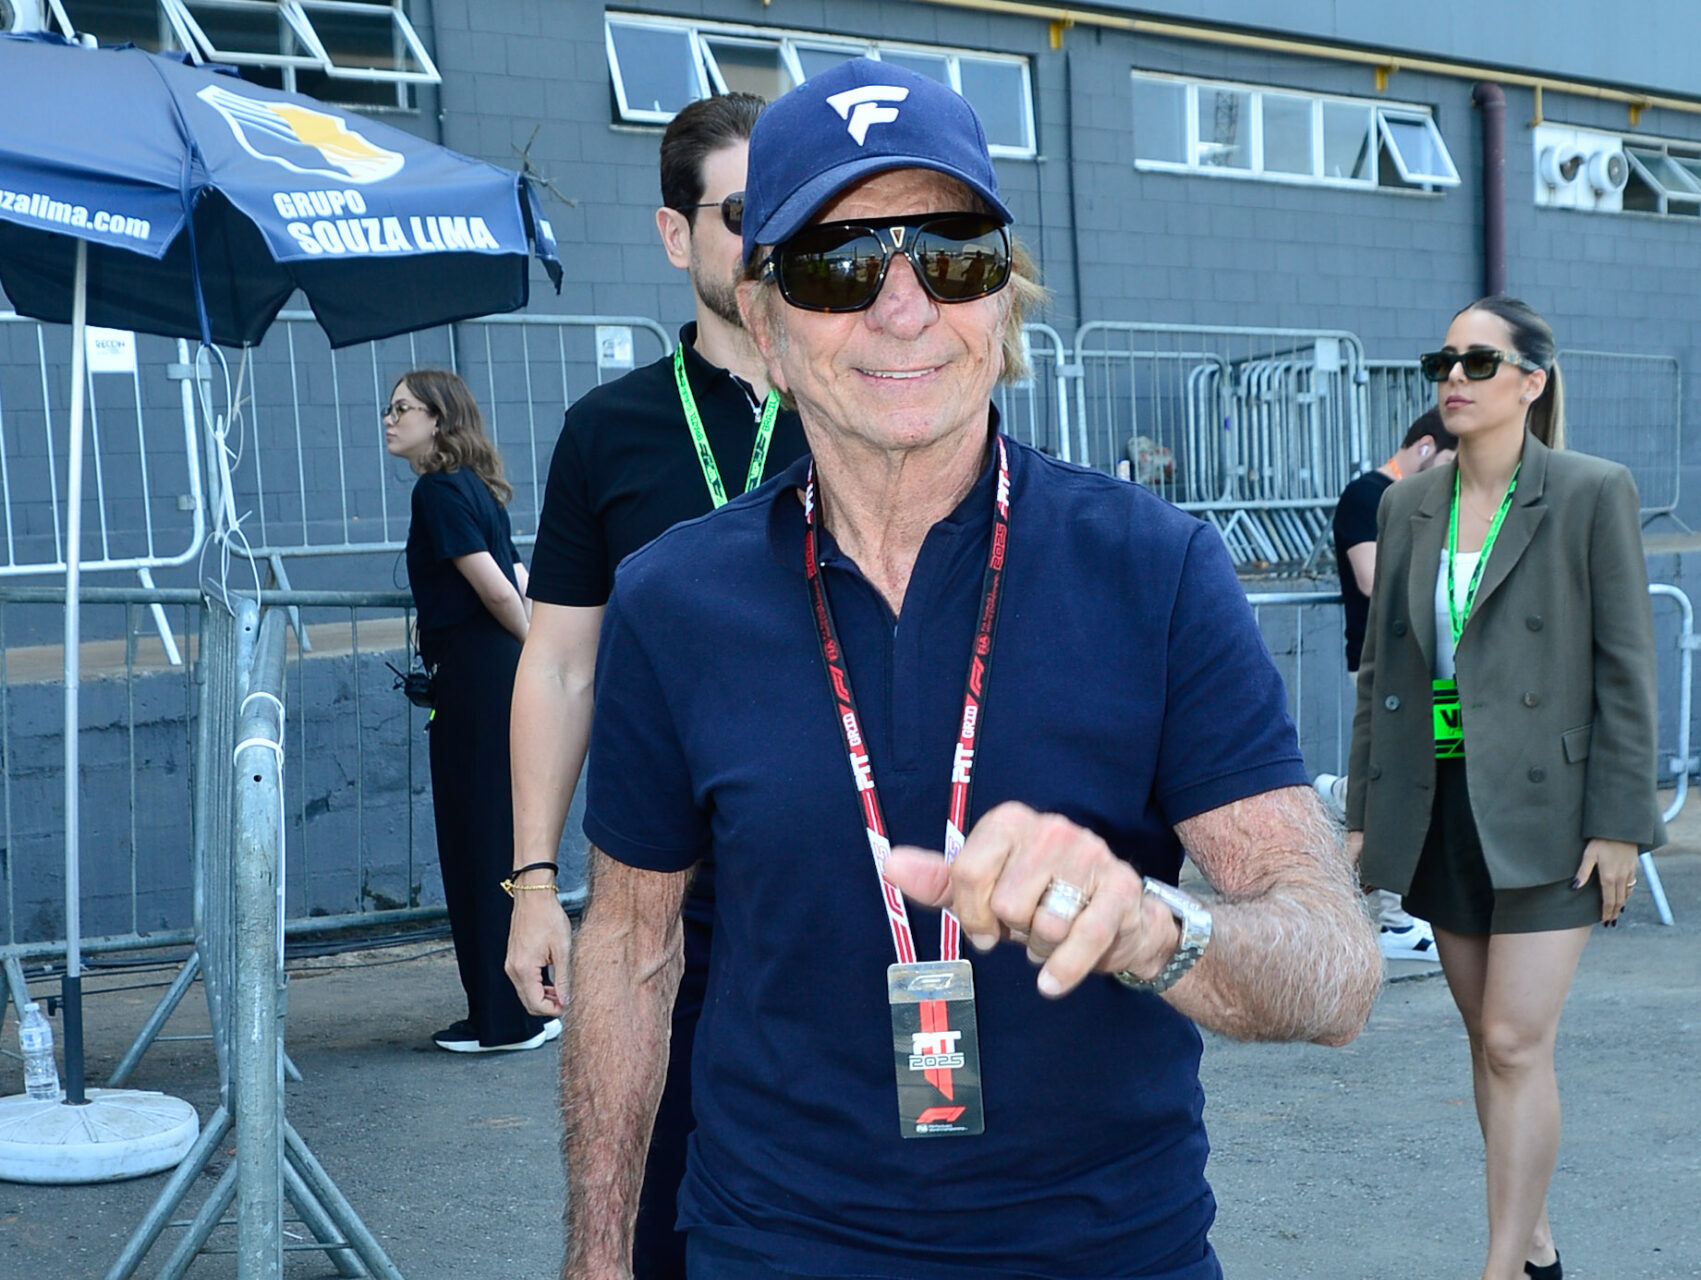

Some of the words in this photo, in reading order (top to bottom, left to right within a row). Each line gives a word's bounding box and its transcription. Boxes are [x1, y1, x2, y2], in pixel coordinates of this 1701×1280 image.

[0, 188, 151, 241] zalima.com
[272, 189, 367, 219] GRUPO
[286, 216, 413, 254] SOUZA
[409, 215, 500, 250] LIMA
[990, 521, 1008, 571] 2025
[842, 711, 862, 747] GRID
[961, 705, 978, 739] GRID
[849, 752, 875, 792] PIT
[951, 742, 975, 784] PIT
[910, 1053, 965, 1070] 2025
[911, 1030, 962, 1056] PIT
